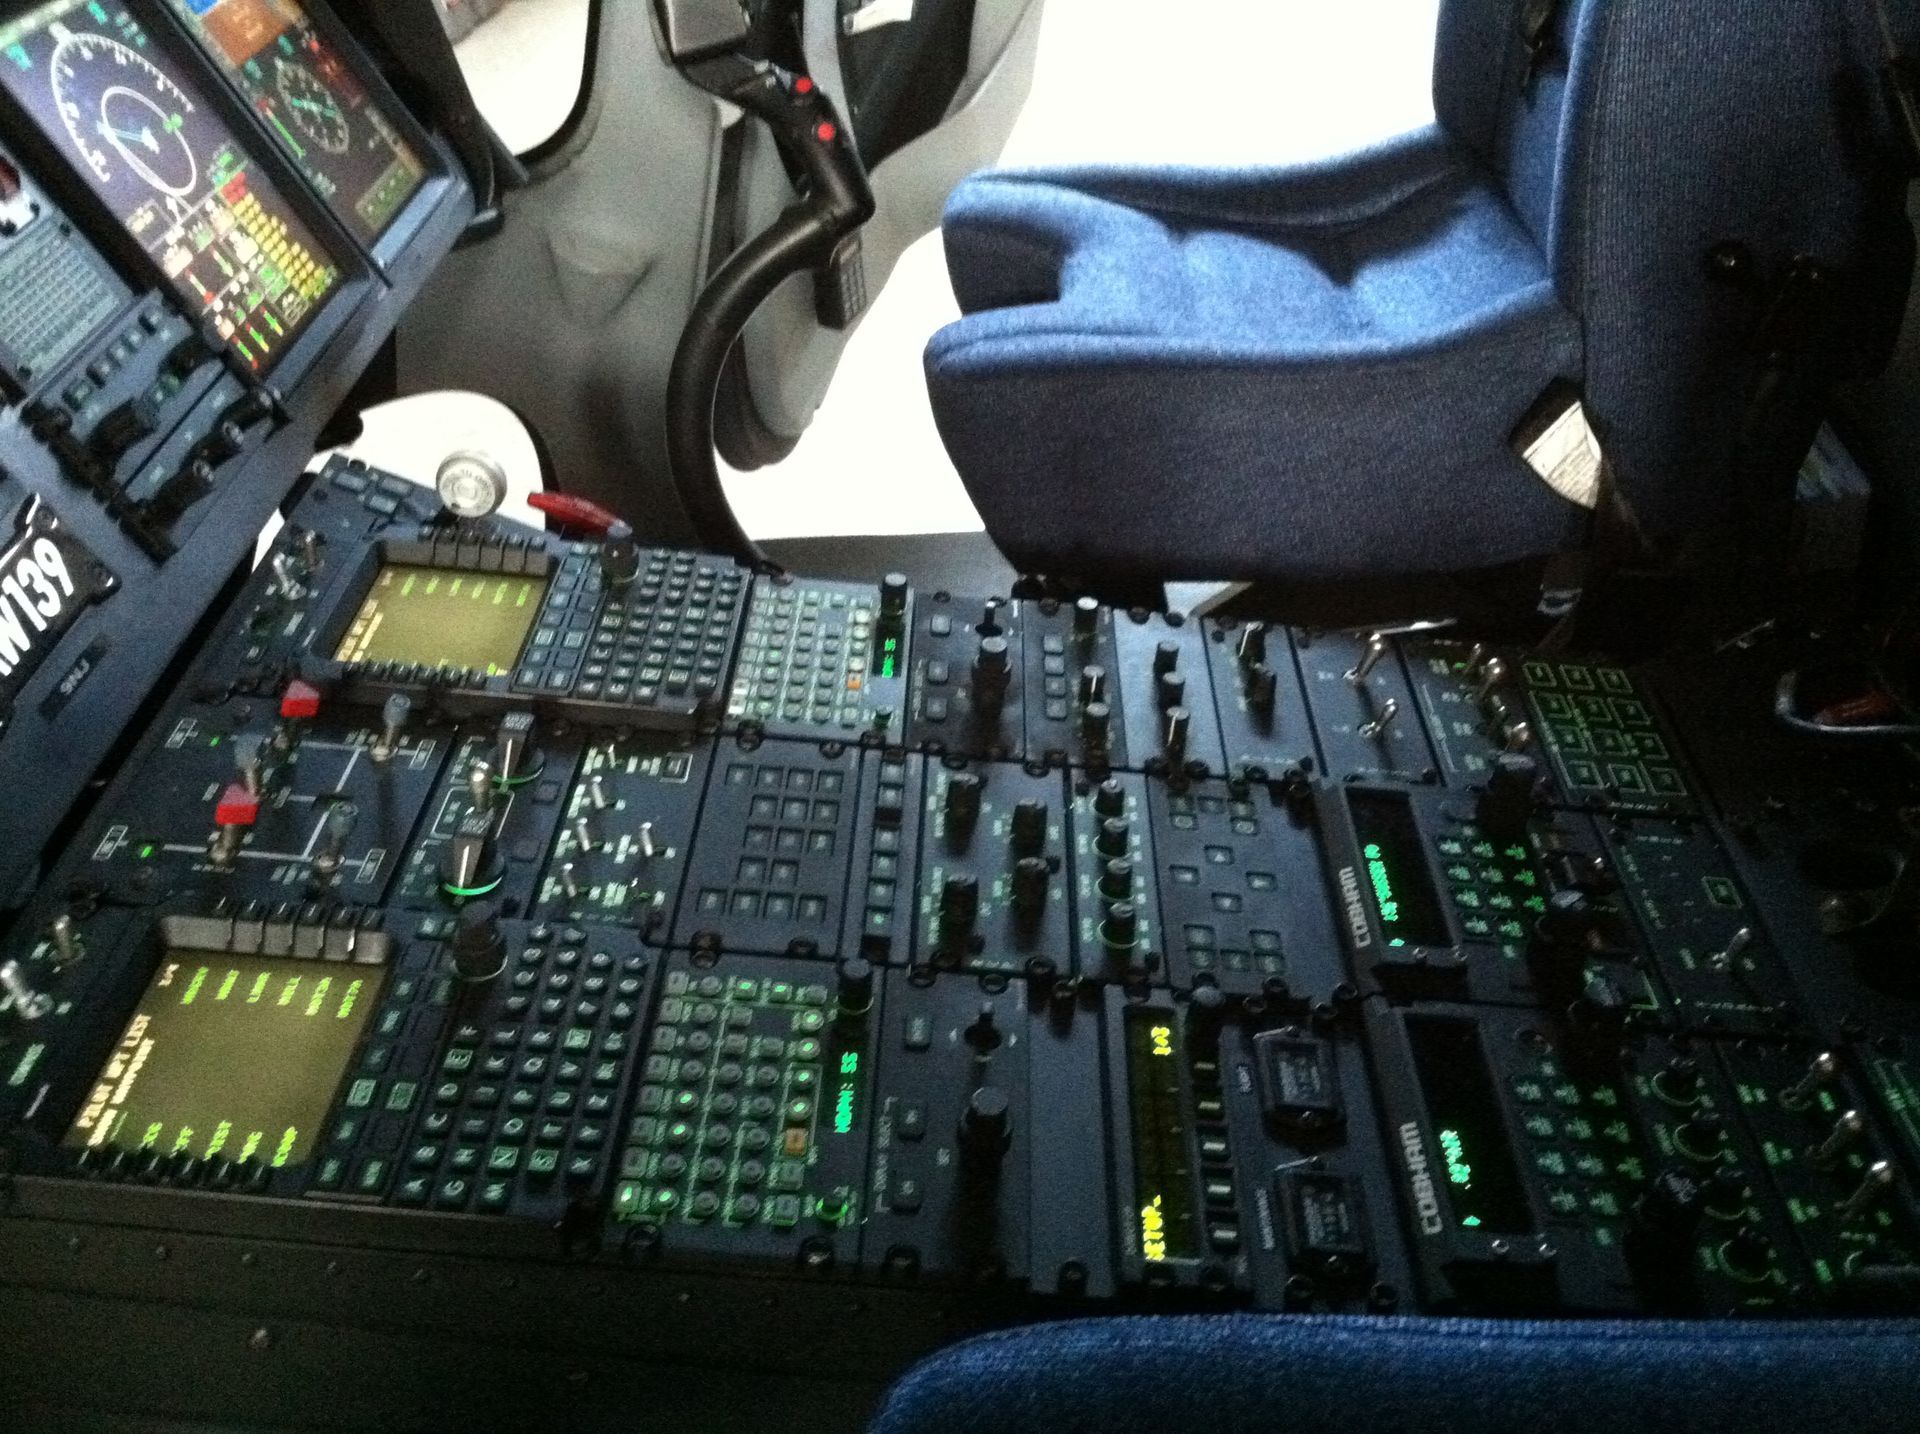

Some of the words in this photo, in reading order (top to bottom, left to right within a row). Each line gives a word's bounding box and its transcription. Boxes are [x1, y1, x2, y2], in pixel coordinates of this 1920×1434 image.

[0, 536, 75, 676] W139
[1337, 866, 1373, 949] COBHAM
[121, 1014, 152, 1047] LIST
[1399, 1121, 1443, 1235] COBHAM
